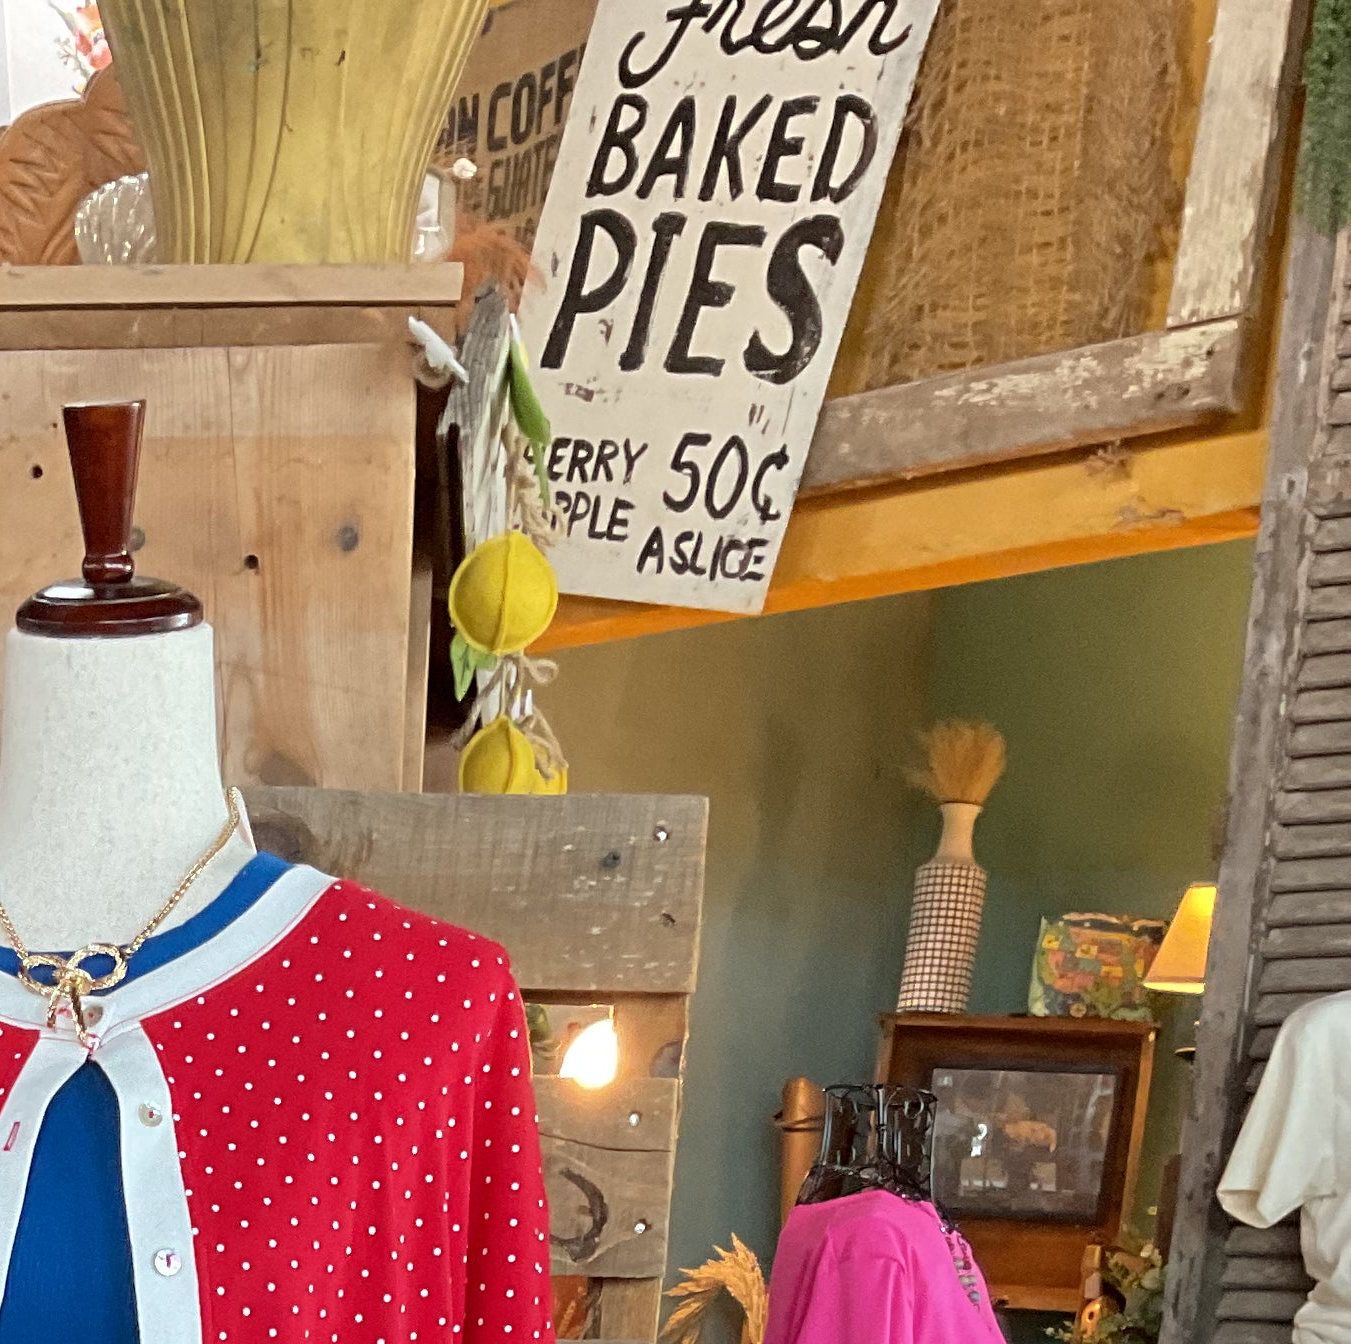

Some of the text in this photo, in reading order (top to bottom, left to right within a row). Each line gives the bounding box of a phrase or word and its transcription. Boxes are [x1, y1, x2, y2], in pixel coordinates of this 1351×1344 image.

[486, 42, 587, 152] COFF
[585, 93, 879, 203] BAKED
[540, 209, 844, 385] PIES
[542, 491, 635, 541] PPLE
